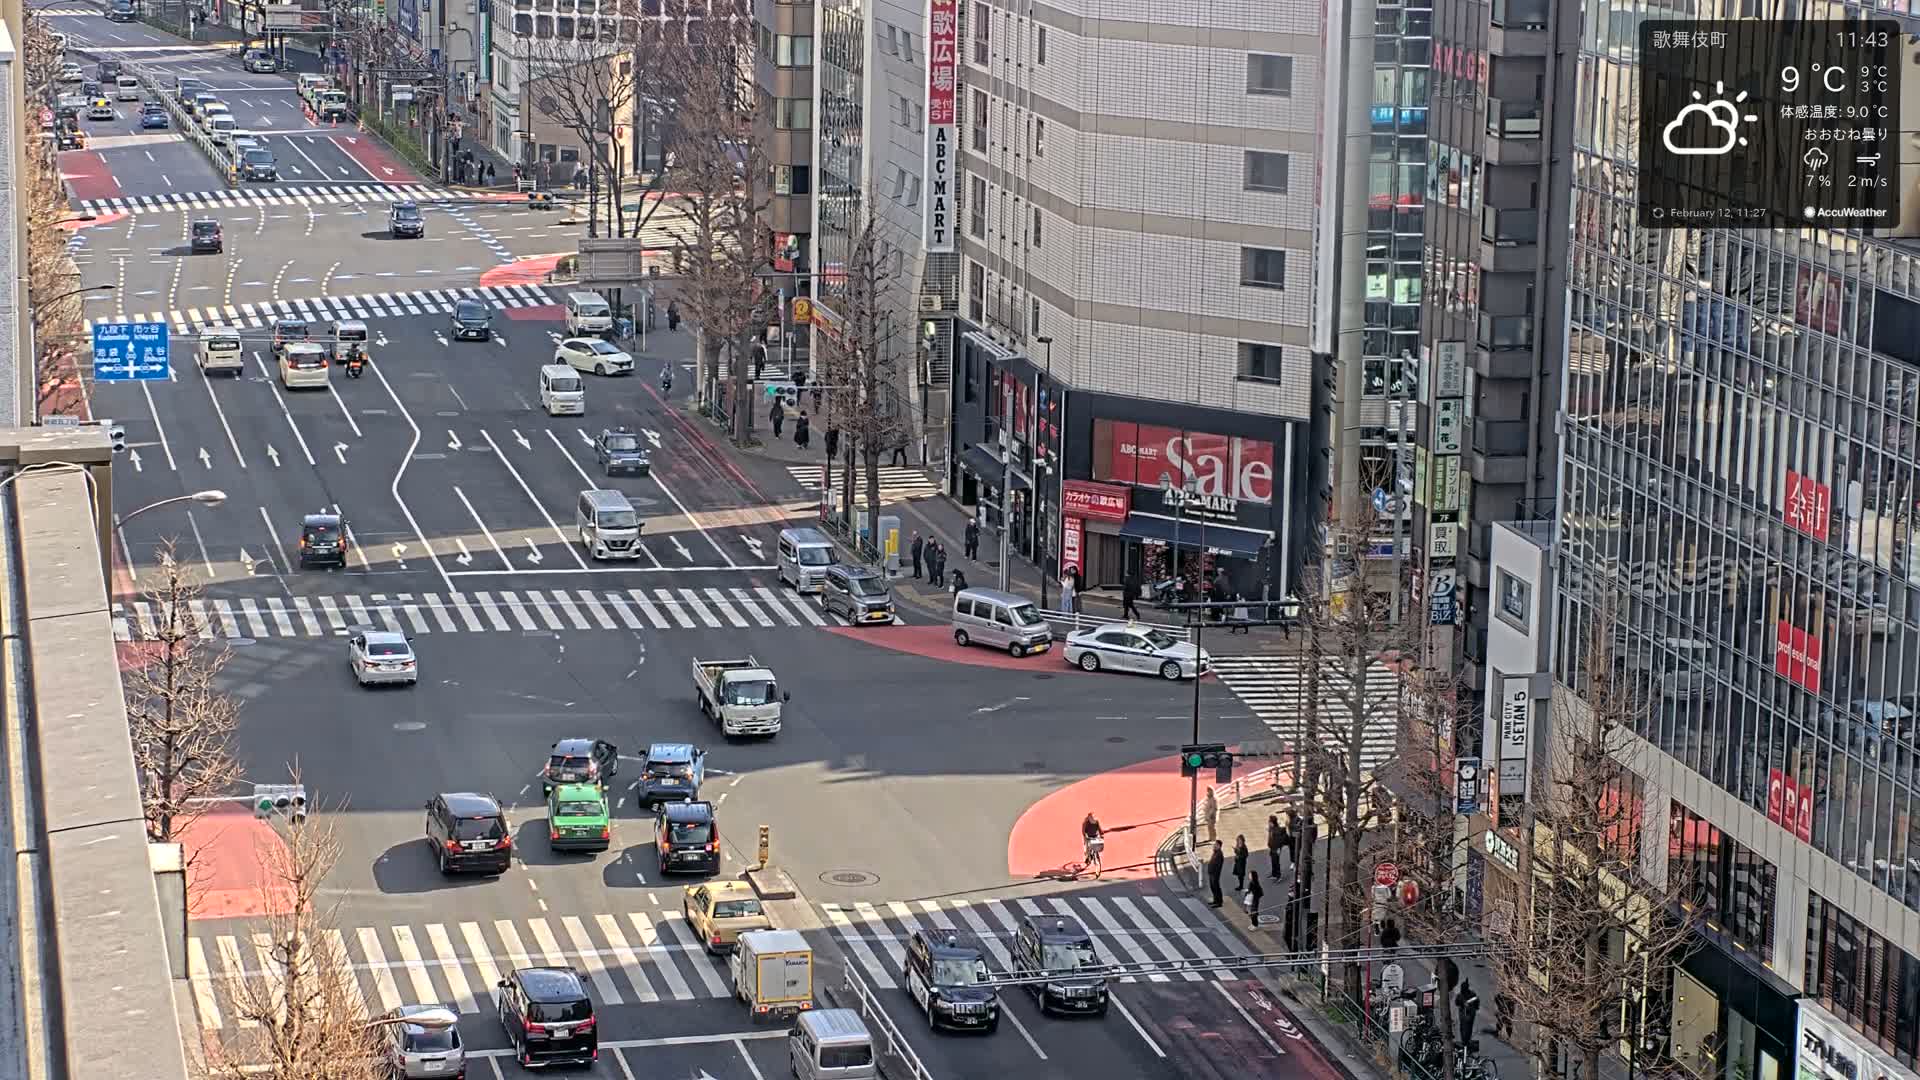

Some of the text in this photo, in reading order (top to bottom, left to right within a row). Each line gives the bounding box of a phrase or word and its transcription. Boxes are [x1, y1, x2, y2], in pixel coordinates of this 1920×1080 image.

[931, 10, 954, 91] 歌広場
[931, 99, 953, 110] 受付
[931, 111, 953, 120] 5F
[1120, 443, 1158, 457] ABCMART
[1166, 436, 1273, 501] Sale
[1789, 481, 1825, 531] 会計
[1777, 641, 1820, 672] professonal
[1504, 701, 1513, 740] PARK CITY
[1512, 690, 1527, 746] ISETAN 5
